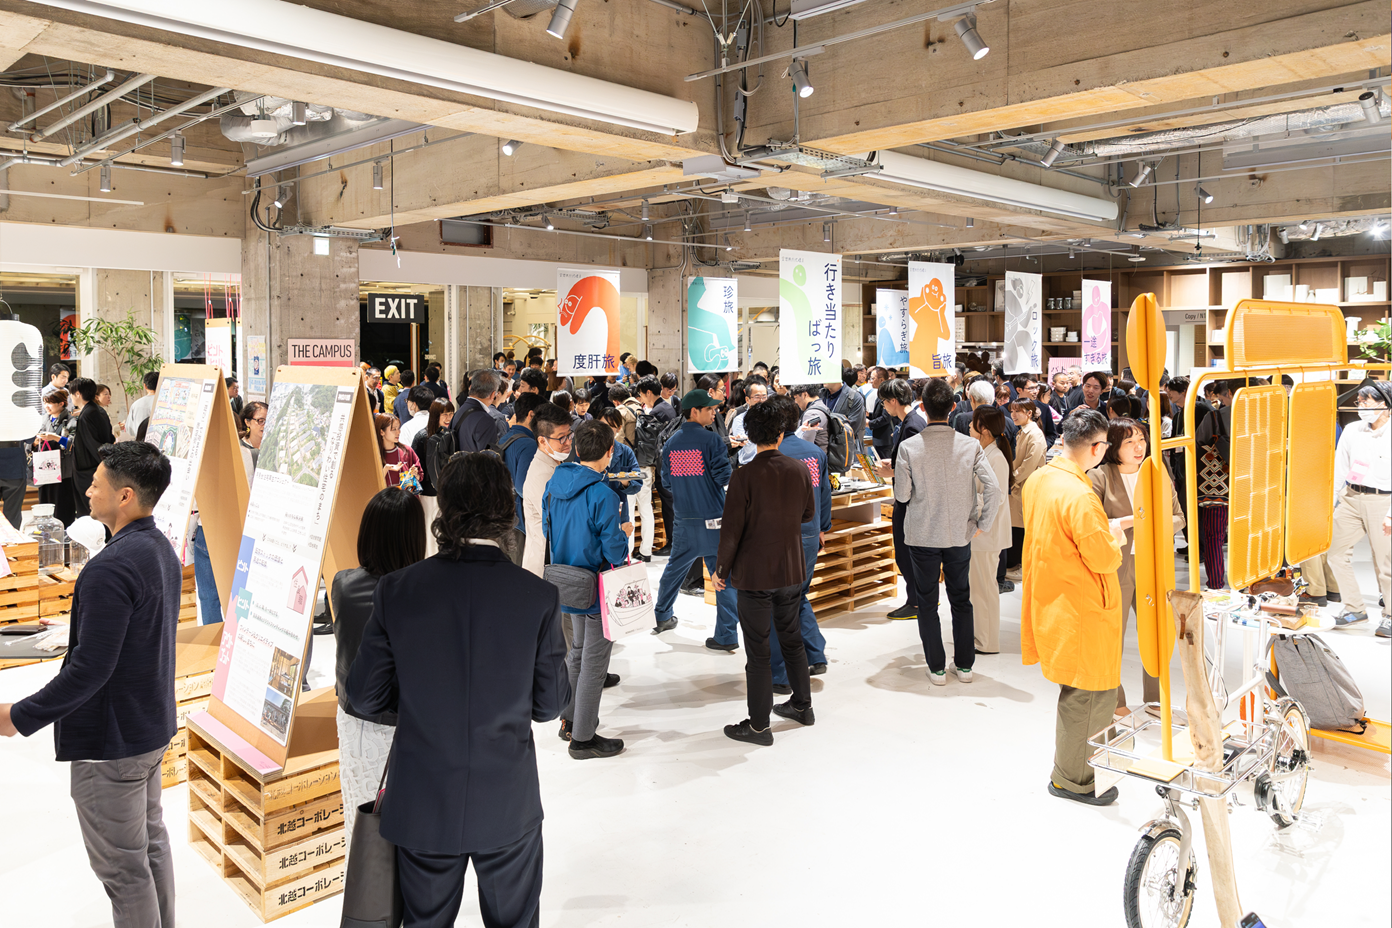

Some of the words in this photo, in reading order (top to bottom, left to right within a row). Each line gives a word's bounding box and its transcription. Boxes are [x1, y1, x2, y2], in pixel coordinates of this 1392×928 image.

[374, 297, 418, 319] EXIT
[723, 285, 734, 314] 珍旅
[824, 263, 837, 359] 行き当たり
[1184, 312, 1196, 320] Copy
[808, 320, 821, 376] ばっ旅
[1031, 311, 1039, 368] ロック旅
[291, 344, 311, 358] THE
[312, 344, 352, 358] CAMPUS
[572, 353, 615, 370] 度肝旅
[932, 353, 952, 370] 旨旅
